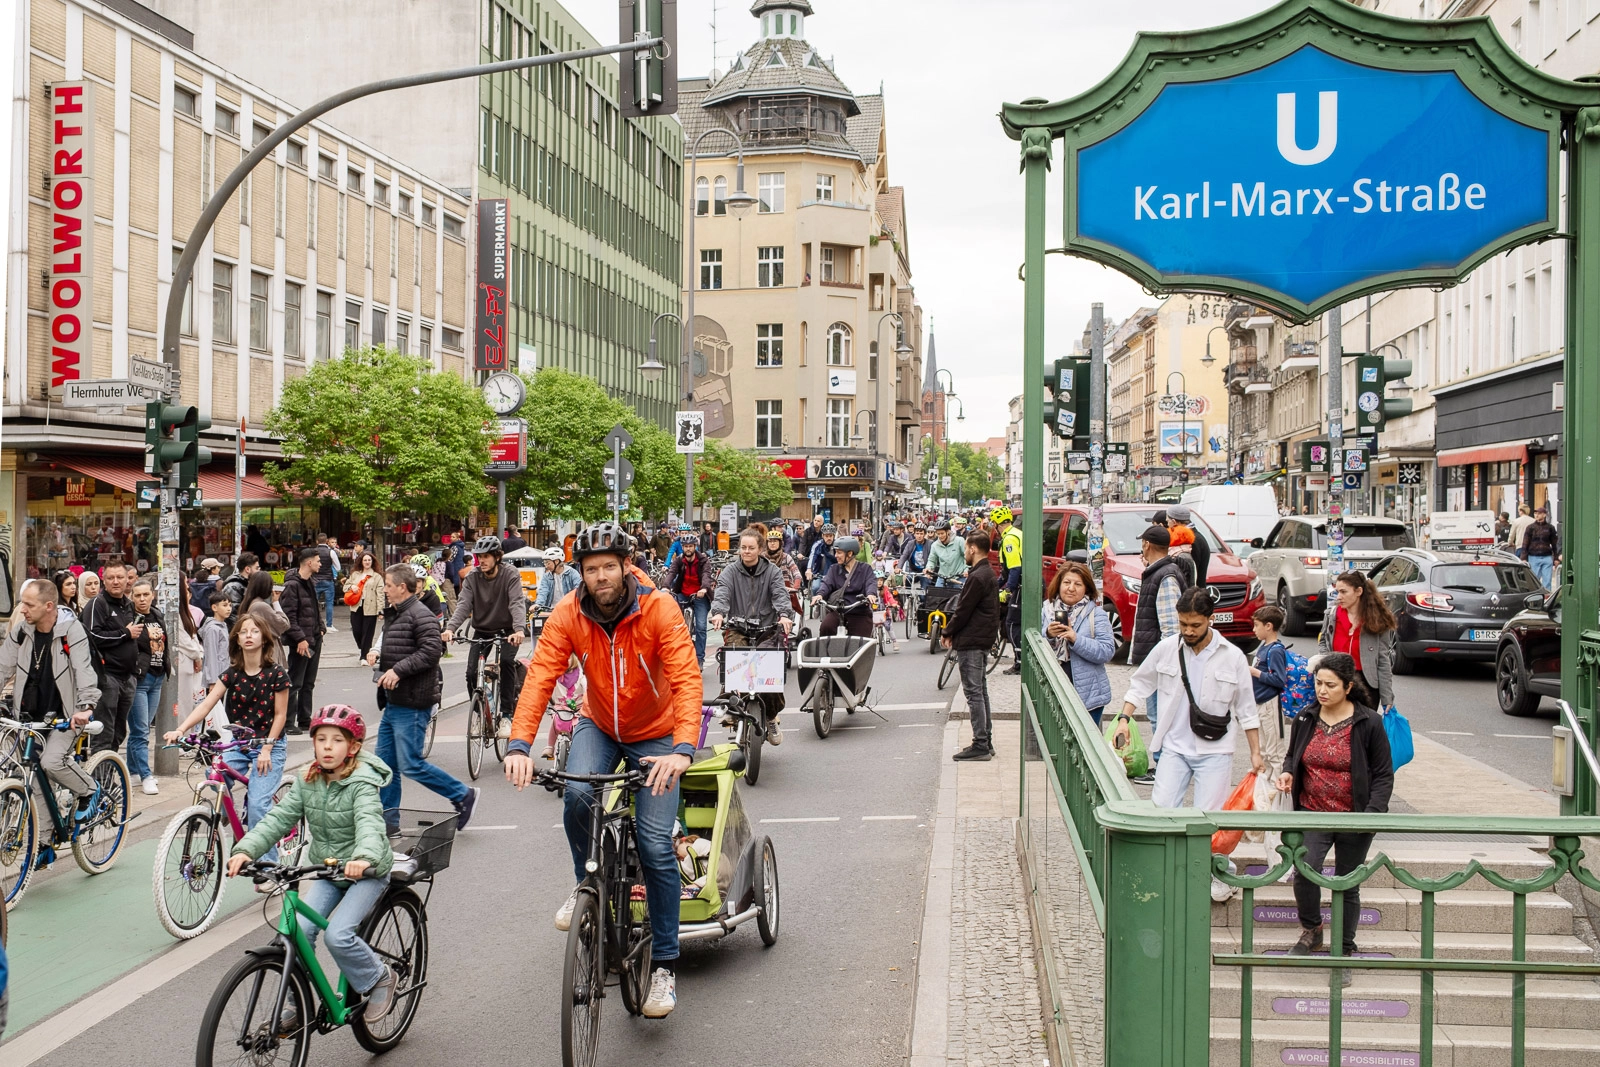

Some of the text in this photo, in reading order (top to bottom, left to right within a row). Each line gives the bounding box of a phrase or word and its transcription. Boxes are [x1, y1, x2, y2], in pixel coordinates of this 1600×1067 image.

[1276, 90, 1338, 166] U
[1134, 172, 1487, 221] Karl-Marx-Straße
[52, 86, 83, 388] WOOLWORTH
[494, 201, 506, 279] SUPERMARKT
[132, 363, 165, 385] Karl-Marx-Straße
[71, 384, 143, 399] Herrnhuter We
[1224, 613, 1233, 622] 55
[1475, 630, 1497, 639] B RS
[765, 677, 775, 686] ALLE
[1267, 911, 1298, 919] WORLD
[1347, 1008, 1386, 1016] INNOVATION
[1288, 1053, 1295, 1062] A
[1349, 1055, 1416, 1066] POSSIBILITIES
